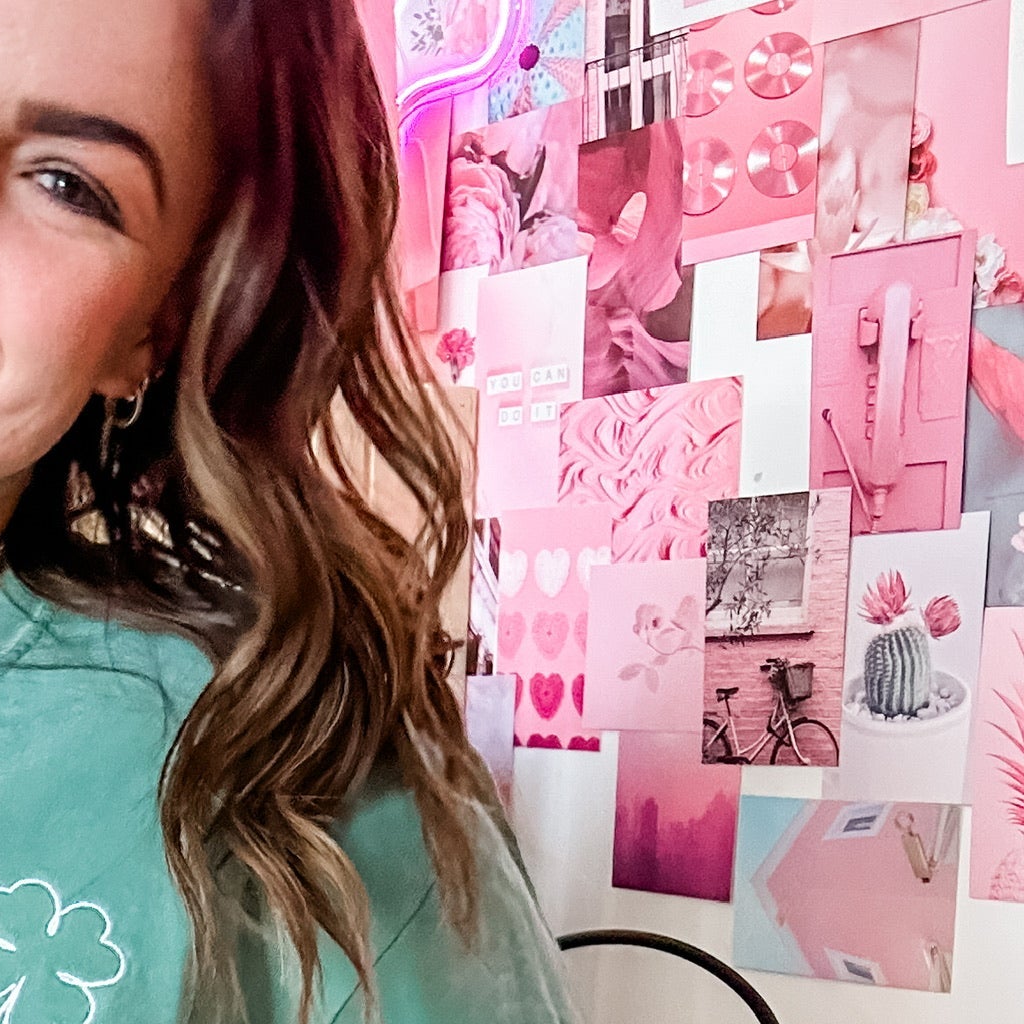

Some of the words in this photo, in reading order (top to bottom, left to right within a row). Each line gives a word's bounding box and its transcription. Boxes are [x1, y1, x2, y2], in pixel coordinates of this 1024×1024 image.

[489, 374, 522, 390] YOU
[532, 367, 566, 384] CAN
[500, 408, 522, 423] DO
[534, 404, 553, 418] IT
